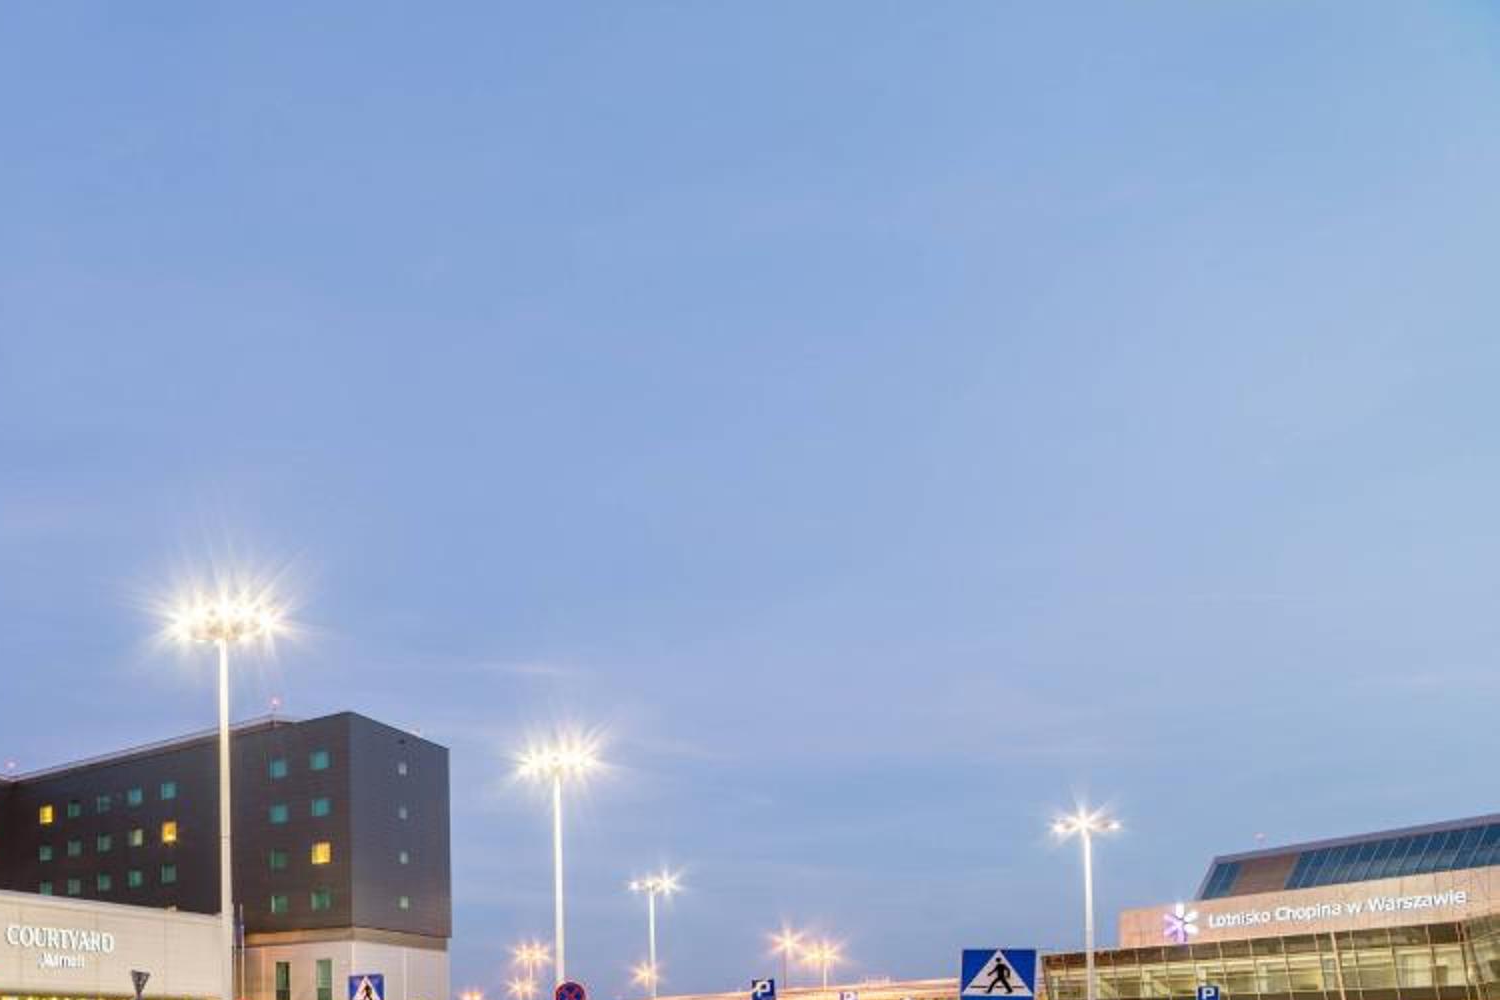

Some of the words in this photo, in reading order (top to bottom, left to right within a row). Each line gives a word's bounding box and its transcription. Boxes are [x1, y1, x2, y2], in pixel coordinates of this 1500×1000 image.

[1208, 908, 1270, 928] Lotnisko
[1275, 903, 1341, 921] Chopina
[1347, 901, 1362, 913] w
[1368, 889, 1466, 912] Warszawie
[5, 926, 116, 953] COURTYARD
[1202, 987, 1216, 1000] P
